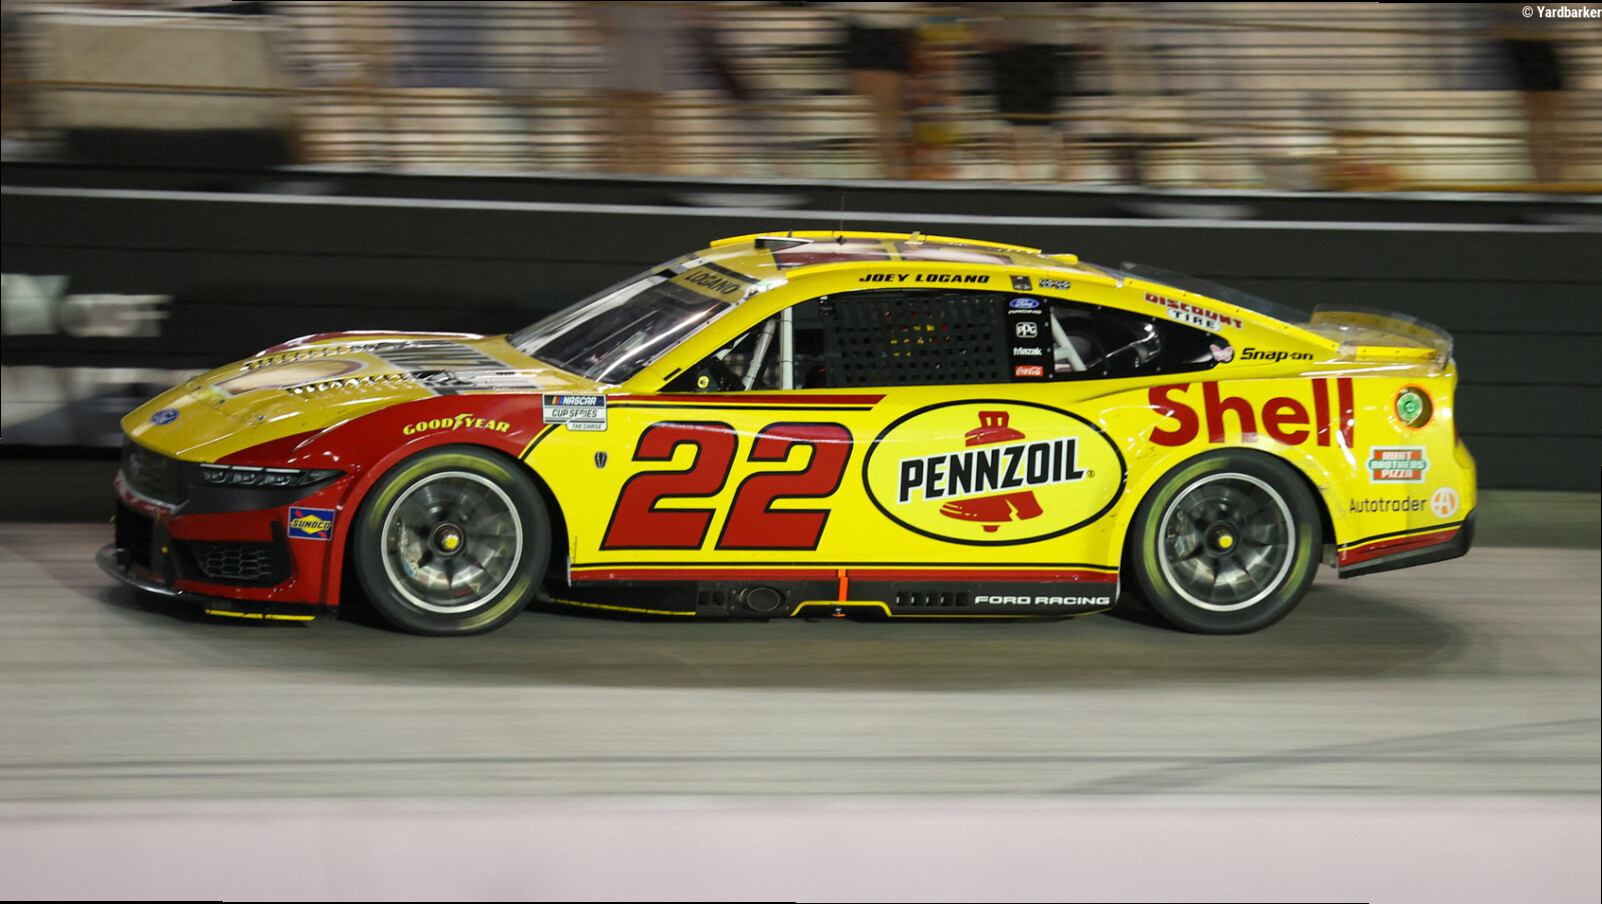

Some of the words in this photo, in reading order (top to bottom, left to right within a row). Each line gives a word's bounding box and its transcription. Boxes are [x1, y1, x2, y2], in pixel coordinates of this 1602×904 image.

[684, 270, 741, 295] LOGANO
[859, 273, 910, 283] JOEY
[915, 274, 990, 283] LOGANO
[1143, 291, 1244, 330] DISCOUNT
[1173, 310, 1216, 330] TIRE
[1013, 346, 1043, 356] Mazak
[1240, 347, 1314, 363] Snap-on
[562, 395, 597, 406] NASCAR
[551, 408, 568, 417] CUP
[569, 408, 598, 418] SERIES
[1148, 376, 1355, 449] Shell
[402, 413, 511, 436] GOODYEAR
[1381, 450, 1414, 461] HUNT
[897, 437, 1087, 504] PENNZOIL
[1370, 460, 1426, 470] BROTHERS
[1380, 469, 1414, 479] PIZZA
[598, 420, 855, 551] 22
[1349, 496, 1428, 513] Autotrader
[292, 519, 331, 530] SUNOCO
[974, 595, 1031, 605] FORD
[1034, 596, 1111, 606] RACING
